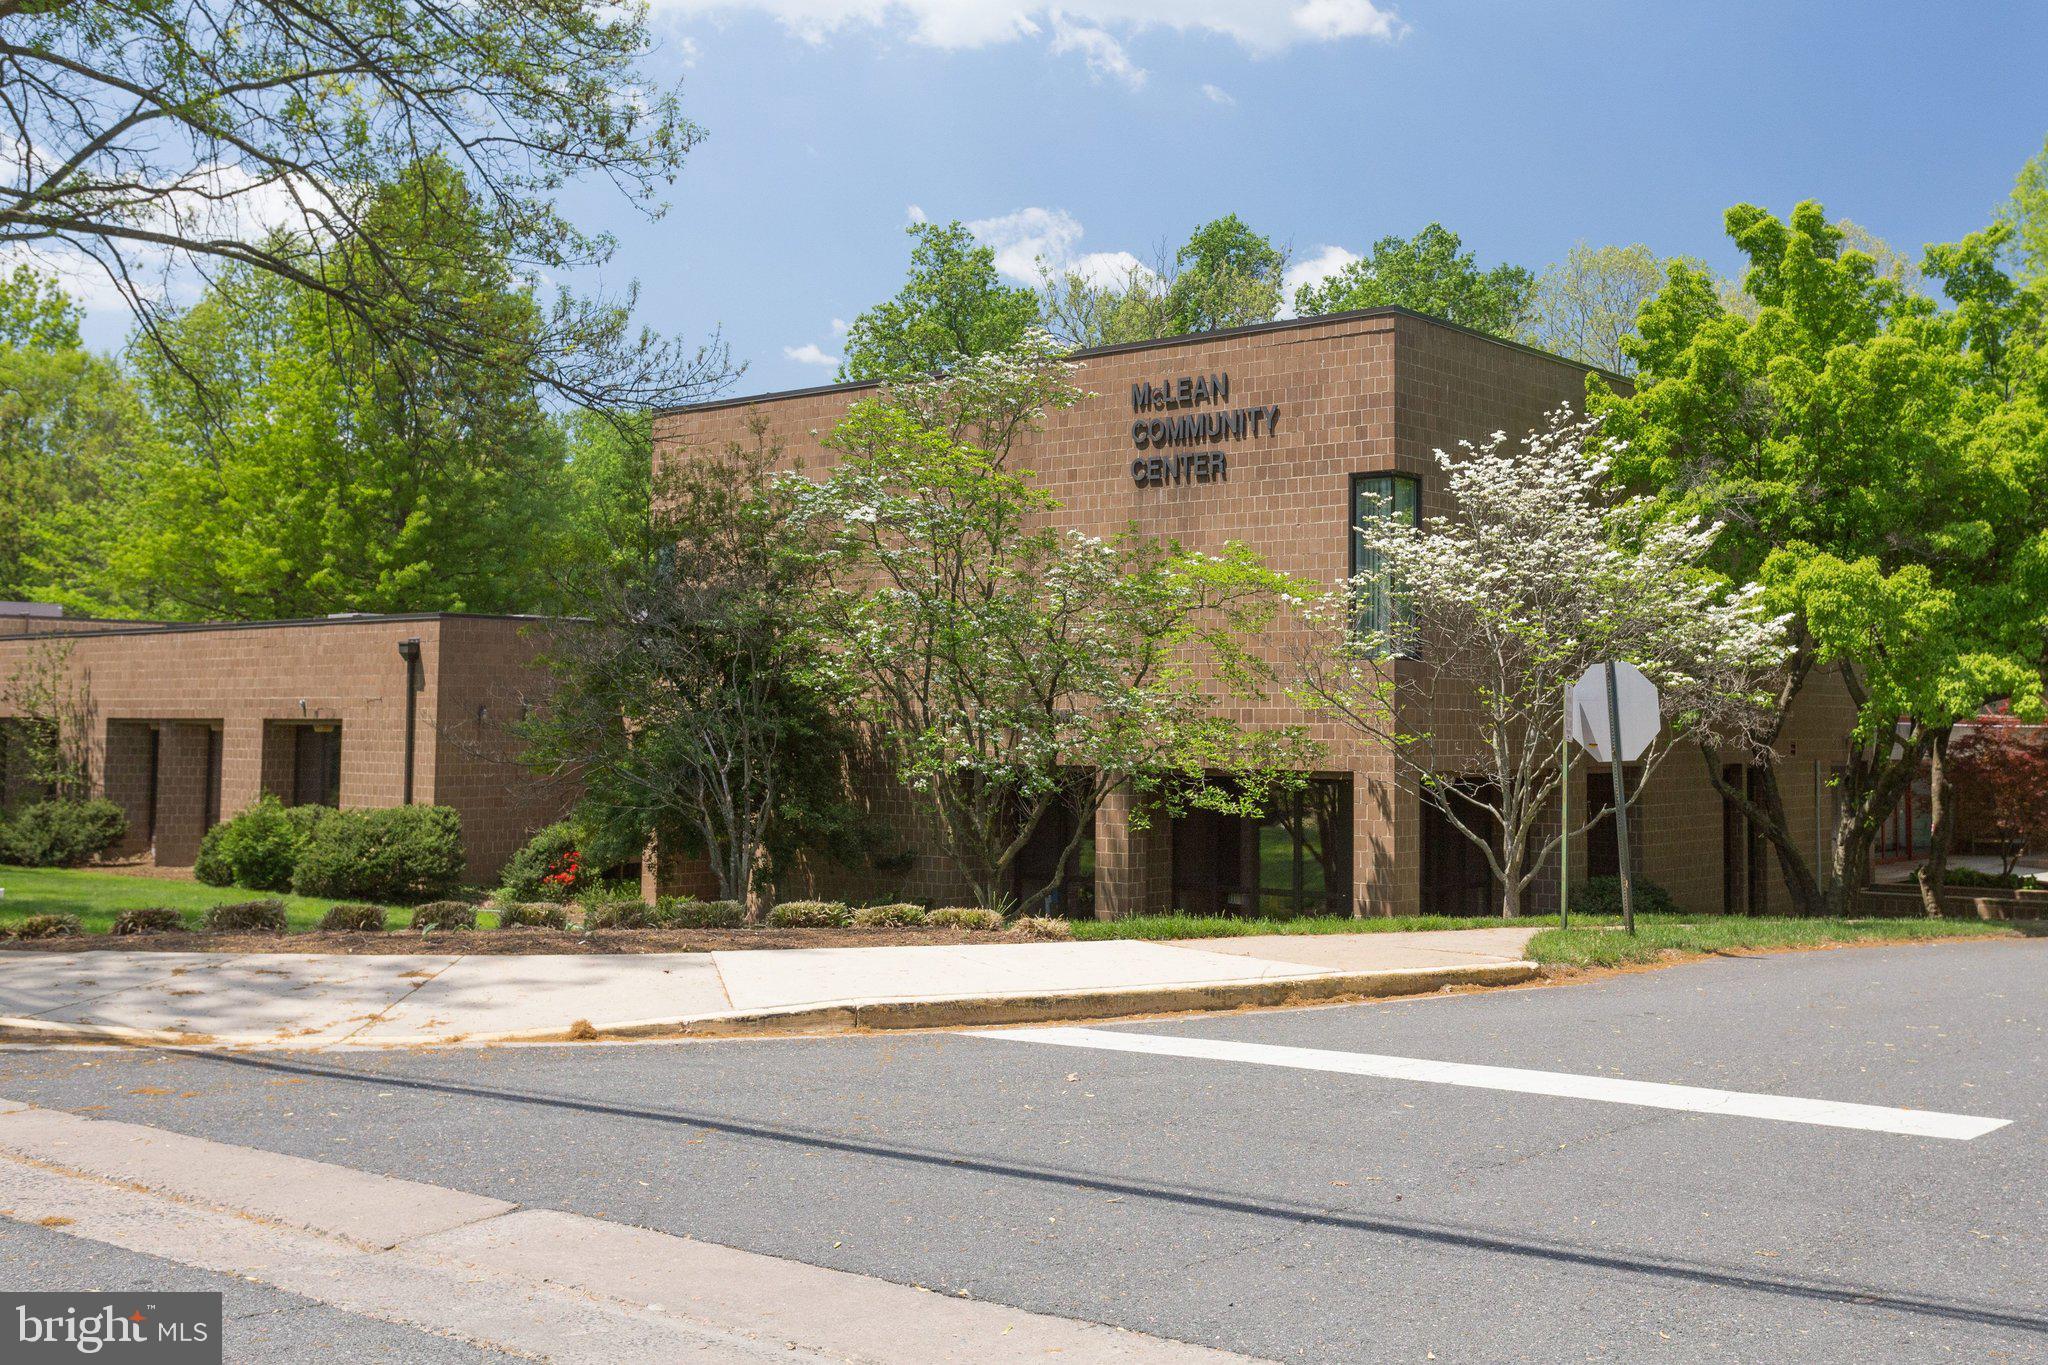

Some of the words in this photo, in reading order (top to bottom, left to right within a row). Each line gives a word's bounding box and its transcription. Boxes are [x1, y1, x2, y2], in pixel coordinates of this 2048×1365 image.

[1131, 372, 1228, 408] McLEAN
[1131, 404, 1279, 444] COMMUNITY
[1130, 450, 1226, 482] CENTER
